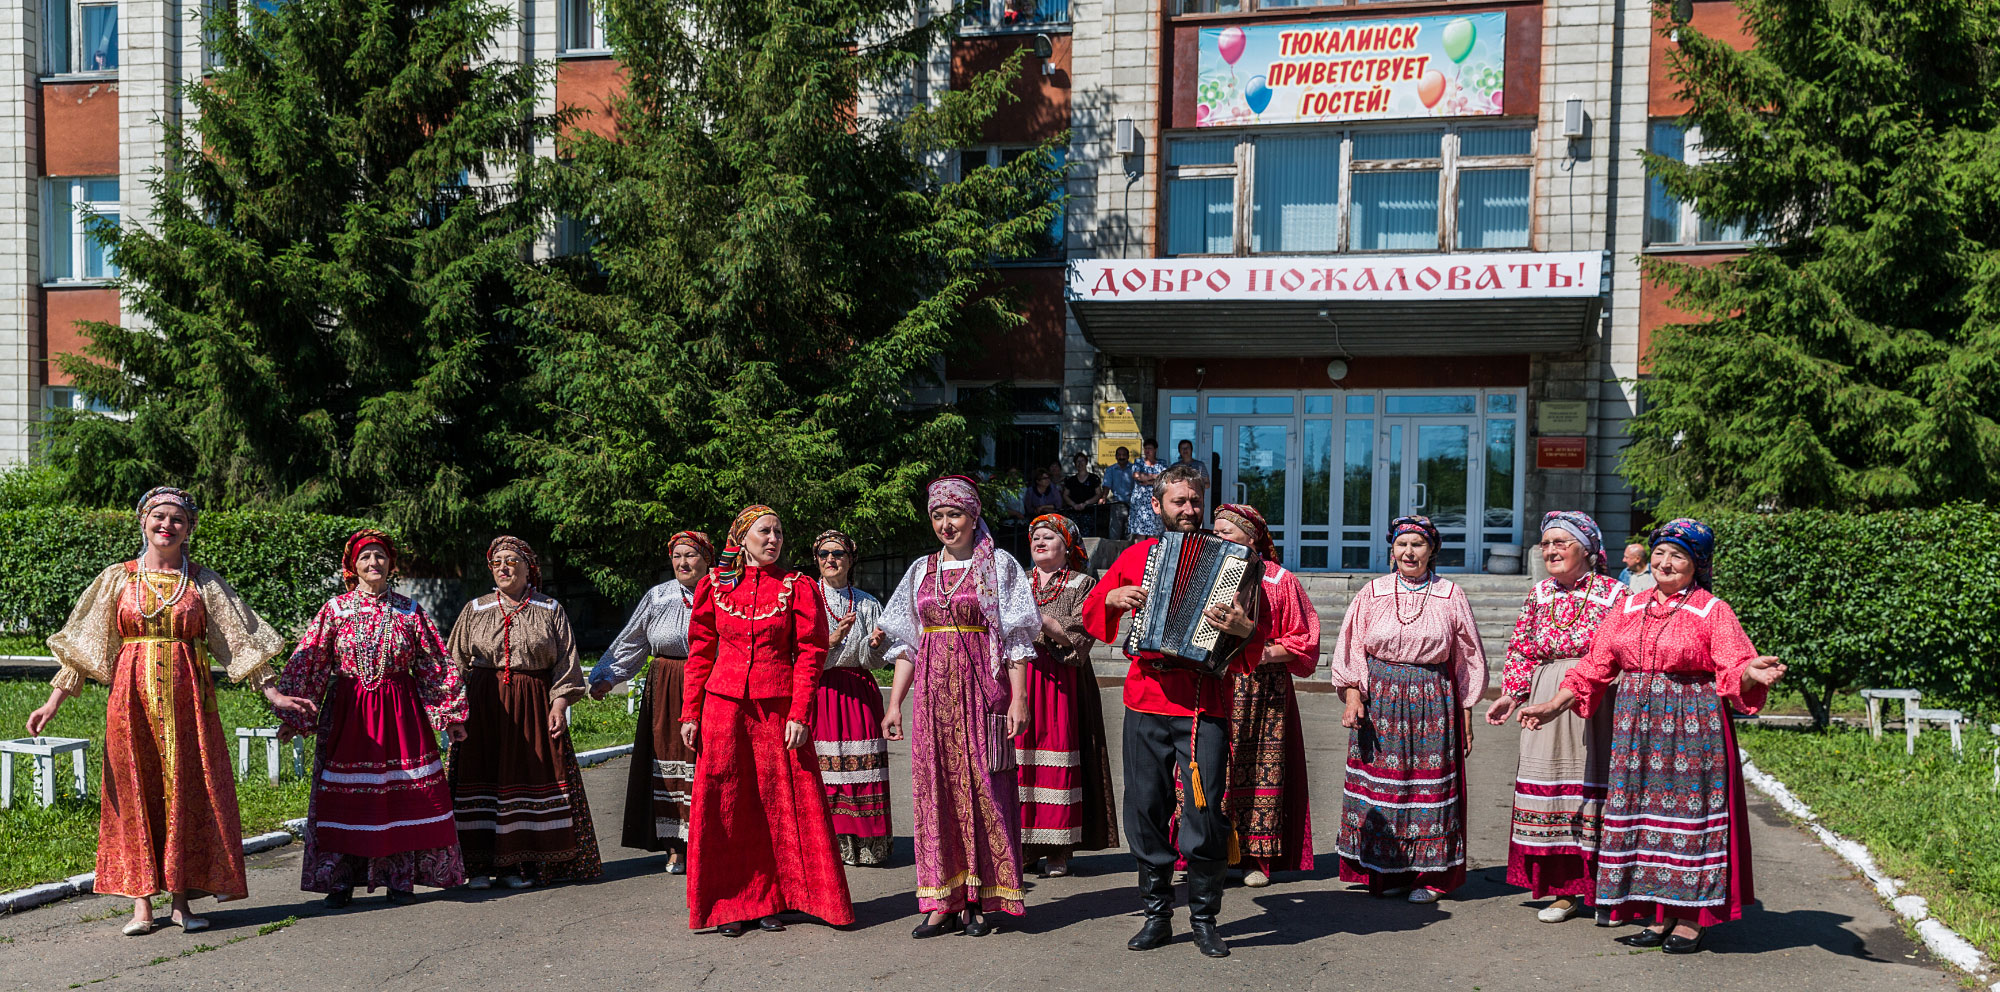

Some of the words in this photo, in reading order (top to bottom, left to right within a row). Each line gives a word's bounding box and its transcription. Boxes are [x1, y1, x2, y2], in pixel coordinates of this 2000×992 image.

[1281, 26, 1419, 56] ТЮКАЛИНСК
[1268, 56, 1429, 87] ПРИВЕТСТВУЕТ
[1302, 85, 1391, 115] ГОСТЕЙ!
[1091, 267, 1231, 297] ДОБРО
[1245, 262, 1585, 292] ПОЖАЛОВАТЬ!
